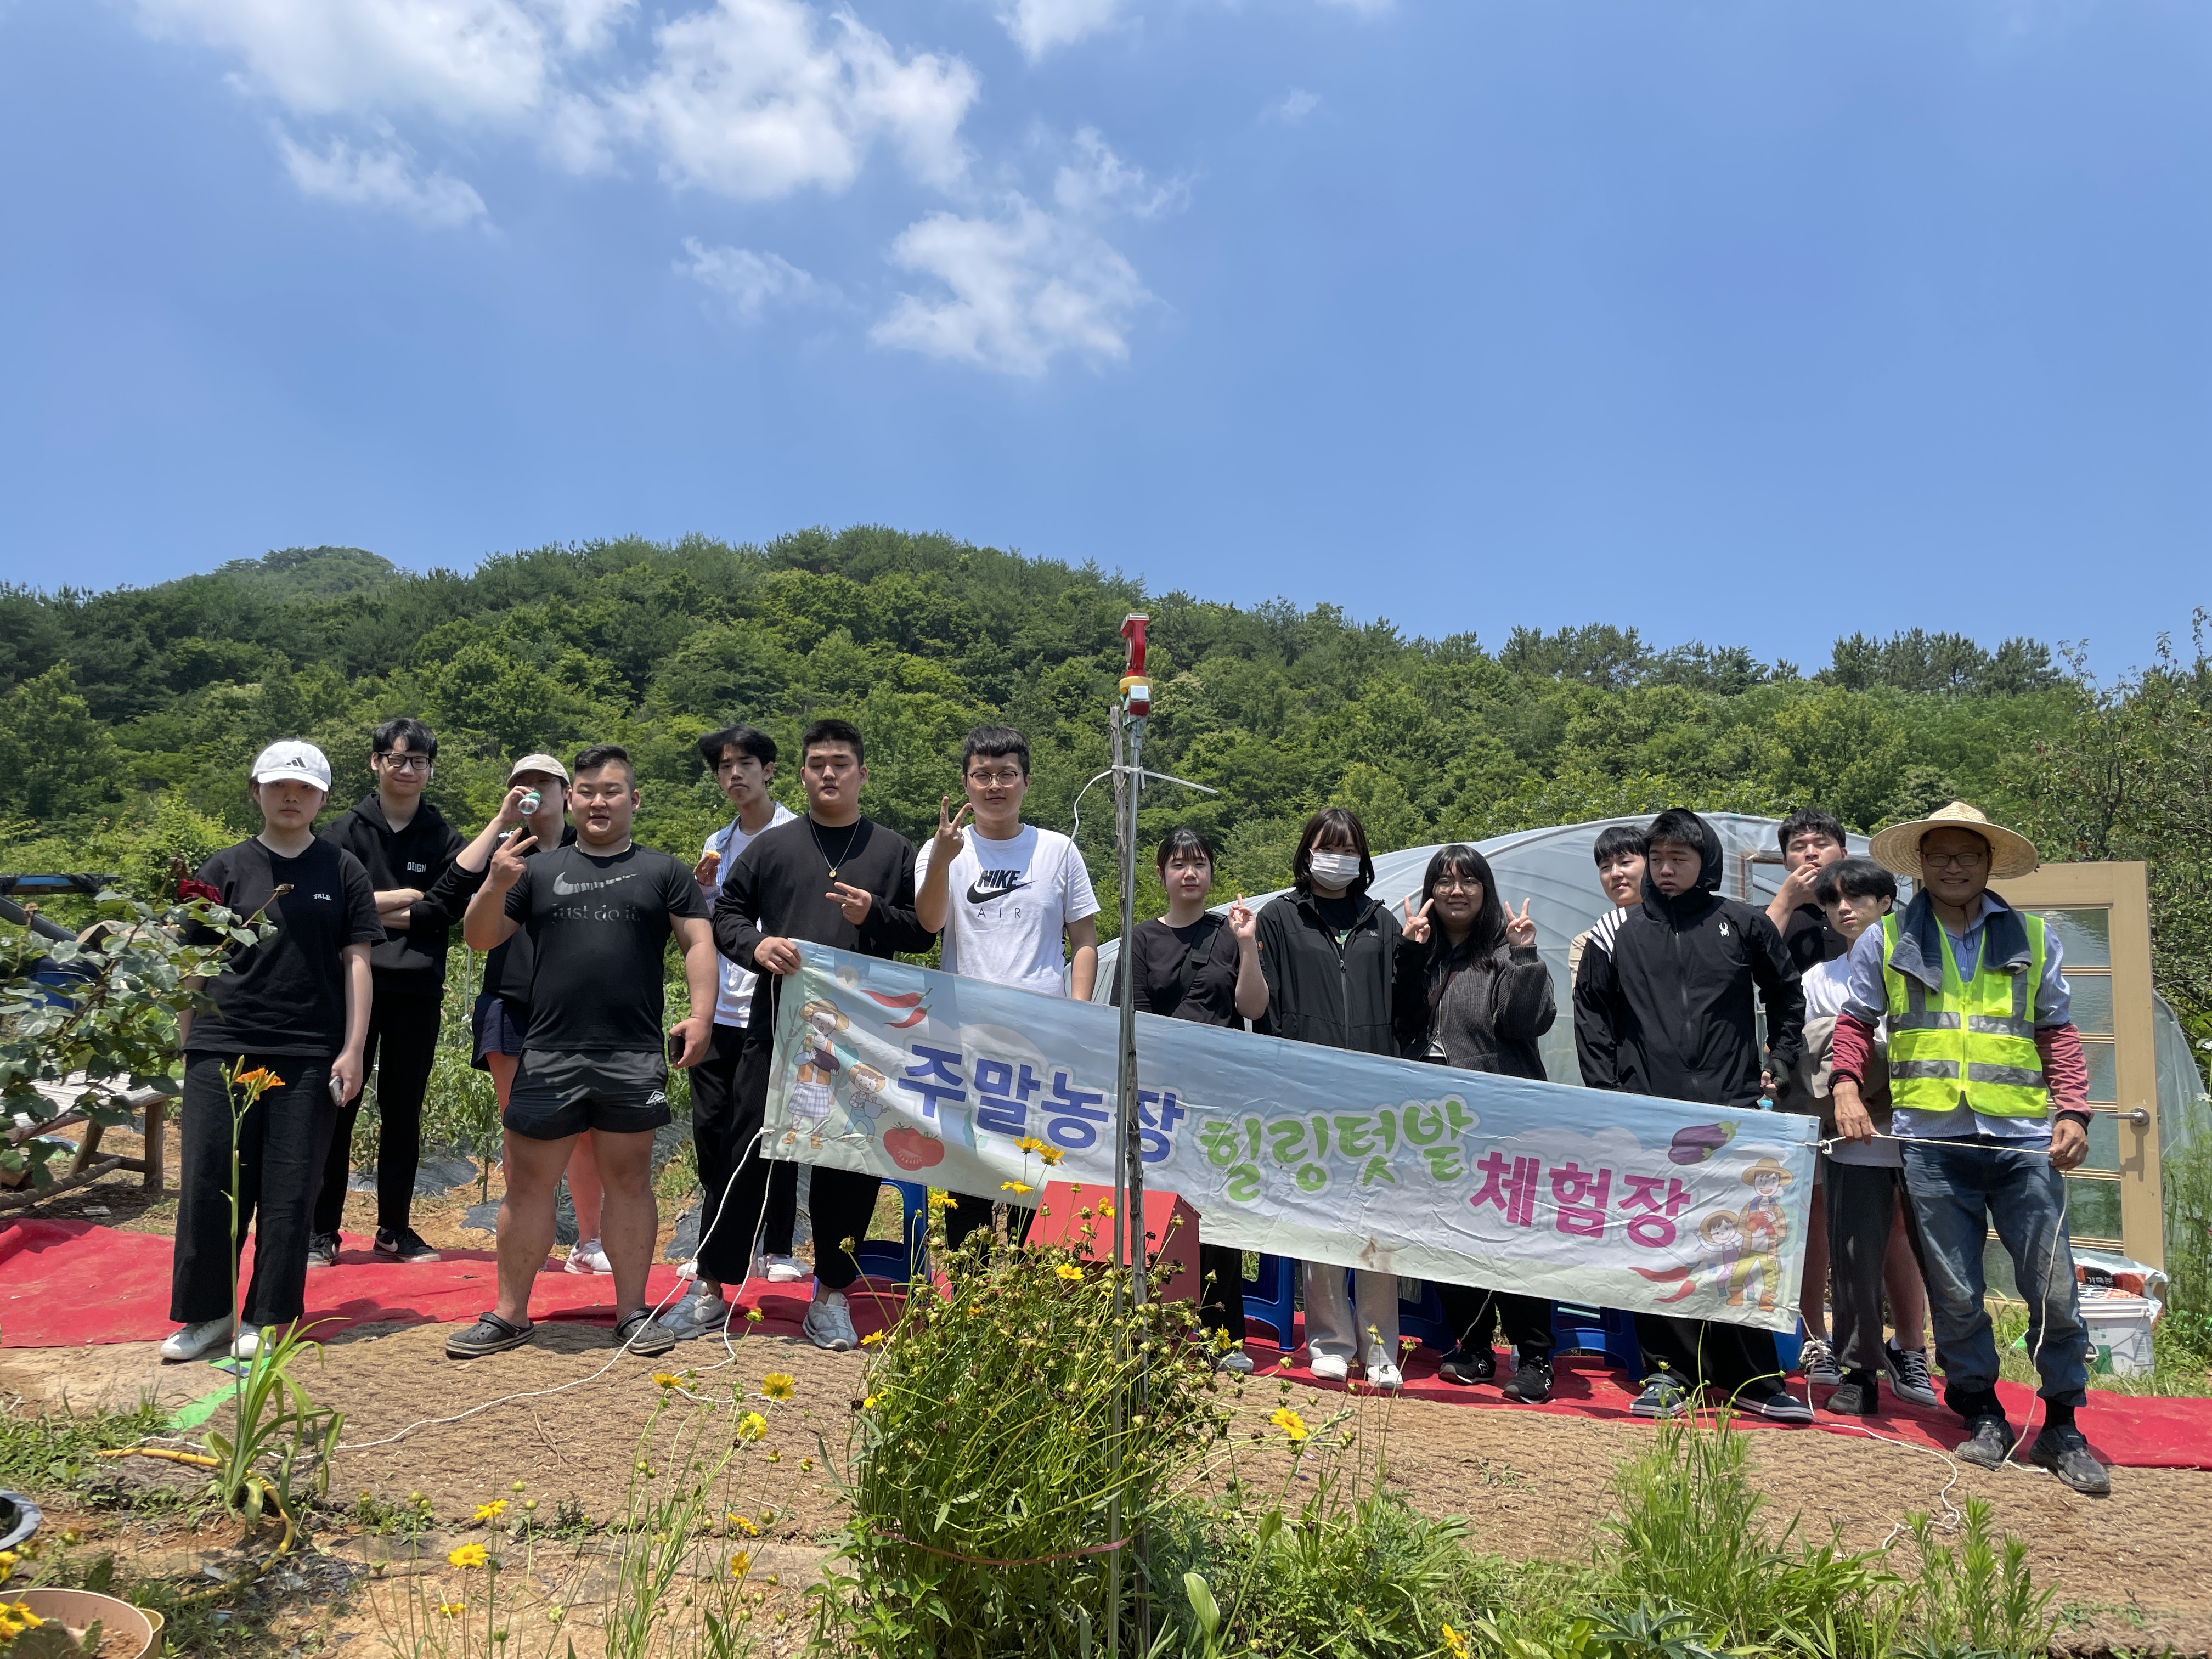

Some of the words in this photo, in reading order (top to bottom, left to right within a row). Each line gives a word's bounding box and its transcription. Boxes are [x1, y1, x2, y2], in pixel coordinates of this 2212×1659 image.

[977, 870, 1021, 889] NIKE
[898, 1044, 1185, 1163] 주말농장
[1199, 1100, 1474, 1201] 힐링텃밭
[1469, 1151, 1691, 1249] 체험장
